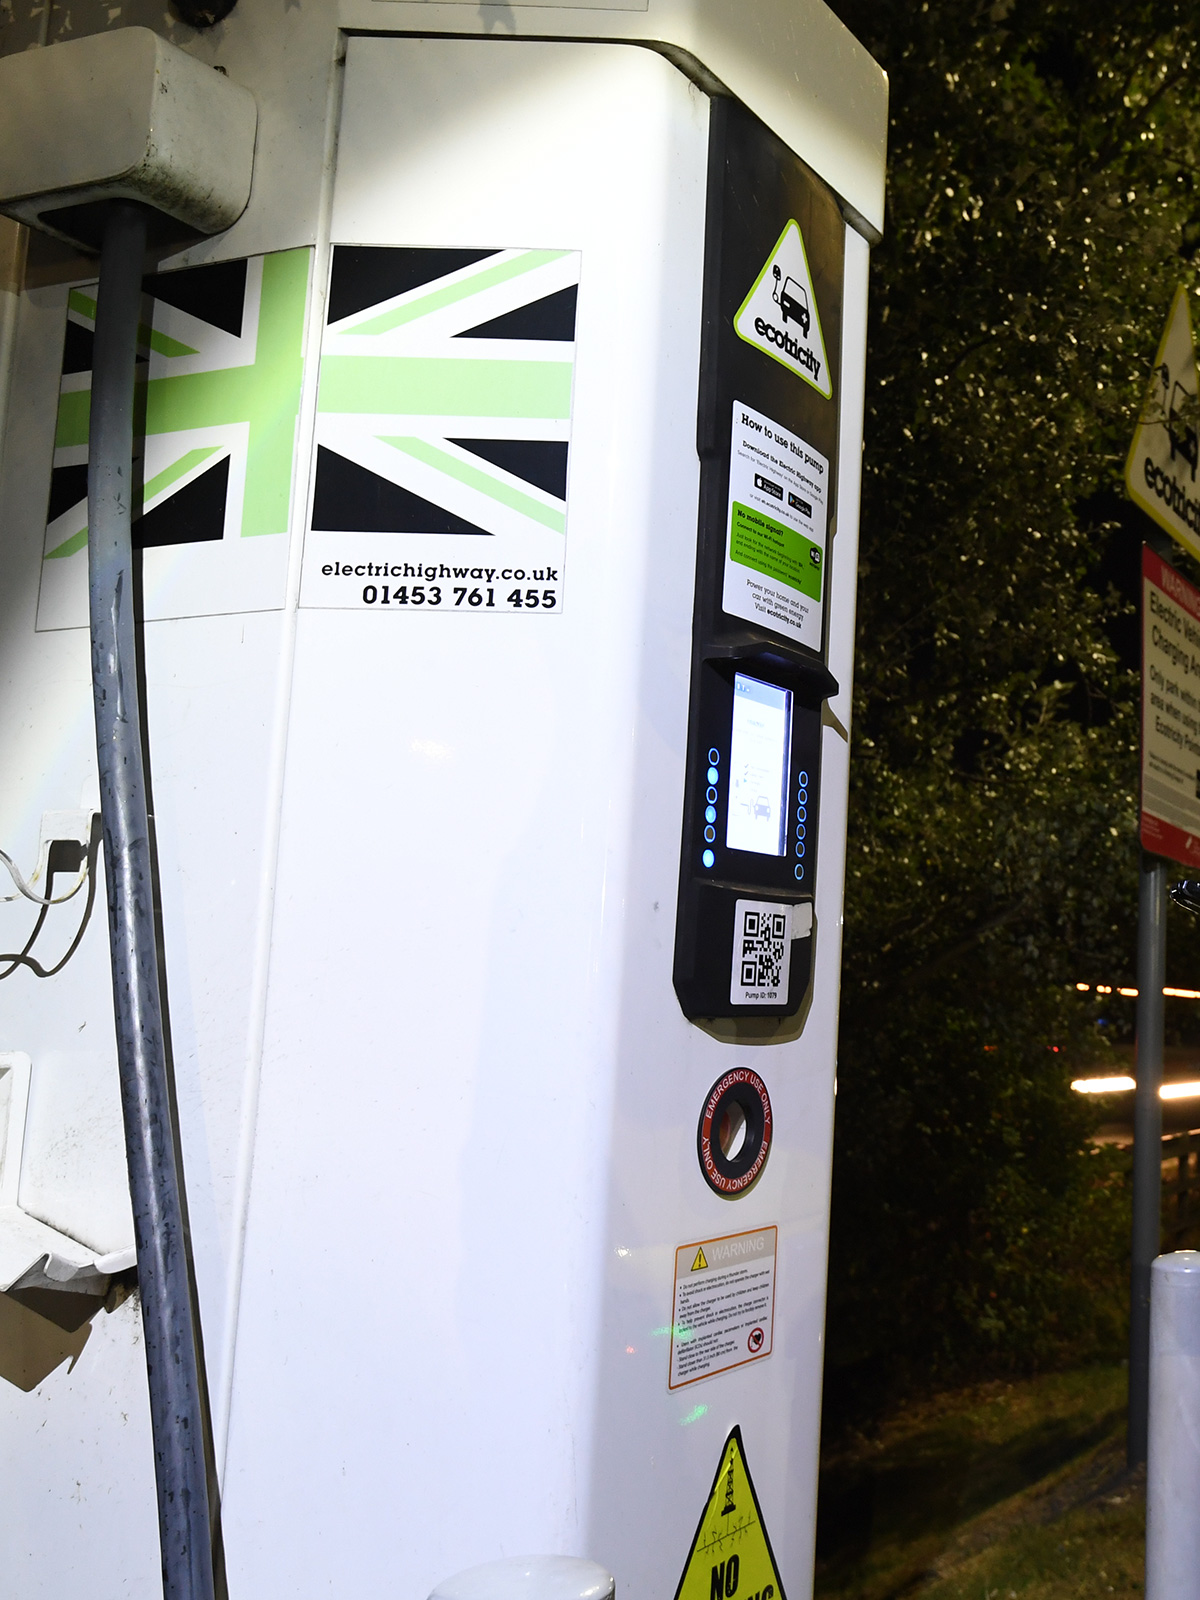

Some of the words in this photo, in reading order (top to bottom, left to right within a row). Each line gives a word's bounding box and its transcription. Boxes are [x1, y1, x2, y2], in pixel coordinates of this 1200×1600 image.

[755, 317, 820, 381] ecotricity
[742, 413, 762, 432] How
[764, 426, 772, 438] to
[775, 434, 788, 448] use
[790, 441, 803, 458] this
[805, 454, 823, 474] pump
[743, 440, 769, 459] Download
[779, 460, 795, 475] Electric
[797, 471, 813, 488] Highway
[737, 522, 752, 532] Connect
[747, 515, 764, 527] mobile
[766, 524, 784, 537] signal?
[321, 561, 558, 582] electrichighway.co.uk
[363, 586, 442, 605] 01453
[454, 588, 495, 606] 761
[507, 589, 556, 608] 455
[747, 579, 763, 591] Power
[764, 588, 775, 597] your
[776, 592, 789, 603] home
[790, 600, 799, 609] and
[800, 605, 809, 613] your
[752, 593, 761, 601] car
[762, 597, 773, 606] with
[774, 602, 788, 613] green
[789, 609, 804, 622] energy
[755, 602, 766, 613] Visit
[767, 609, 801, 629] ecotricity.co.uk
[1151, 591, 1181, 633] Electric
[1152, 625, 1189, 674] Charging
[1150, 664, 1164, 690] Only
[745, 992, 759, 1000] Pump
[706, 1070, 749, 1118] EMERGENCY
[750, 1075, 763, 1094] USE
[761, 1093, 770, 1124] ONLY
[703, 1136, 713, 1169] ONLY
[727, 1141, 768, 1189] EMERGENCY
[711, 1169, 725, 1188] USE
[712, 1236, 764, 1260] WARNING
[710, 1554, 739, 1600] NO
